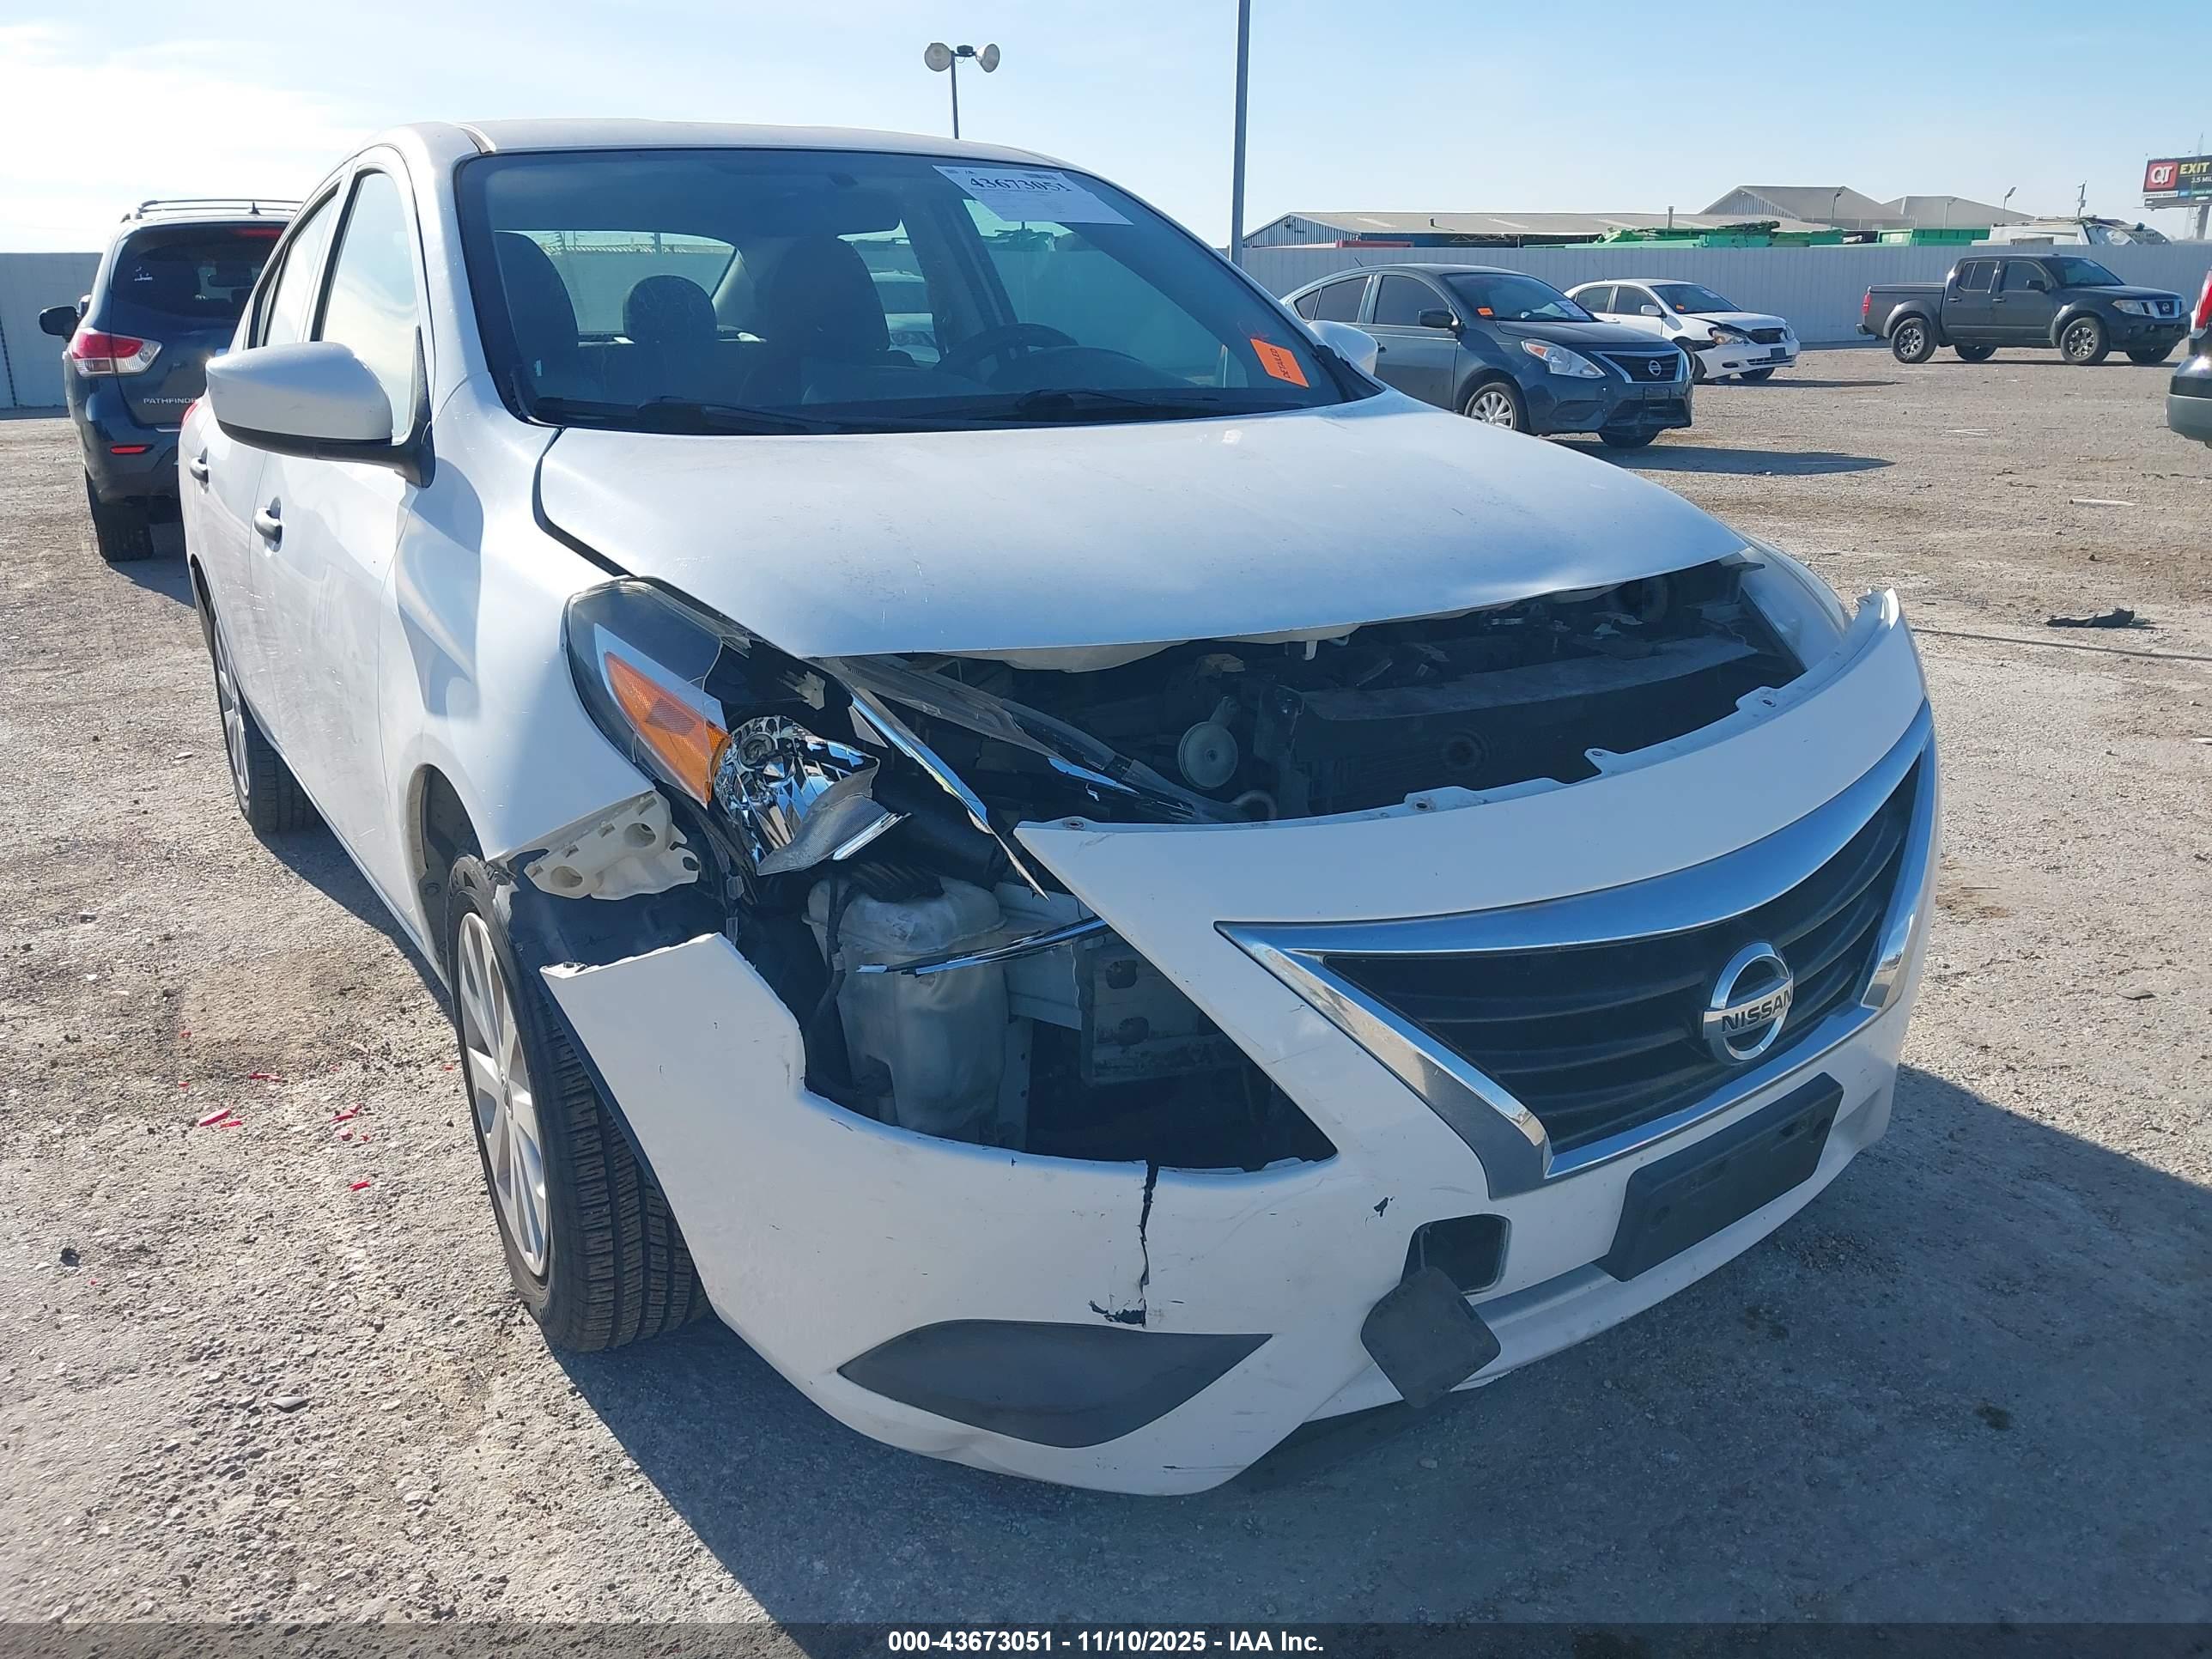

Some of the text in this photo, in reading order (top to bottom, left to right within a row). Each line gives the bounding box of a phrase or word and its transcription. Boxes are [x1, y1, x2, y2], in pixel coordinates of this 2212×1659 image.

[2150, 166, 2173, 185] QT
[2179, 162, 2210, 174] EXIT
[969, 177, 1073, 192] 43673051
[1722, 986, 1792, 1032] NISSAN
